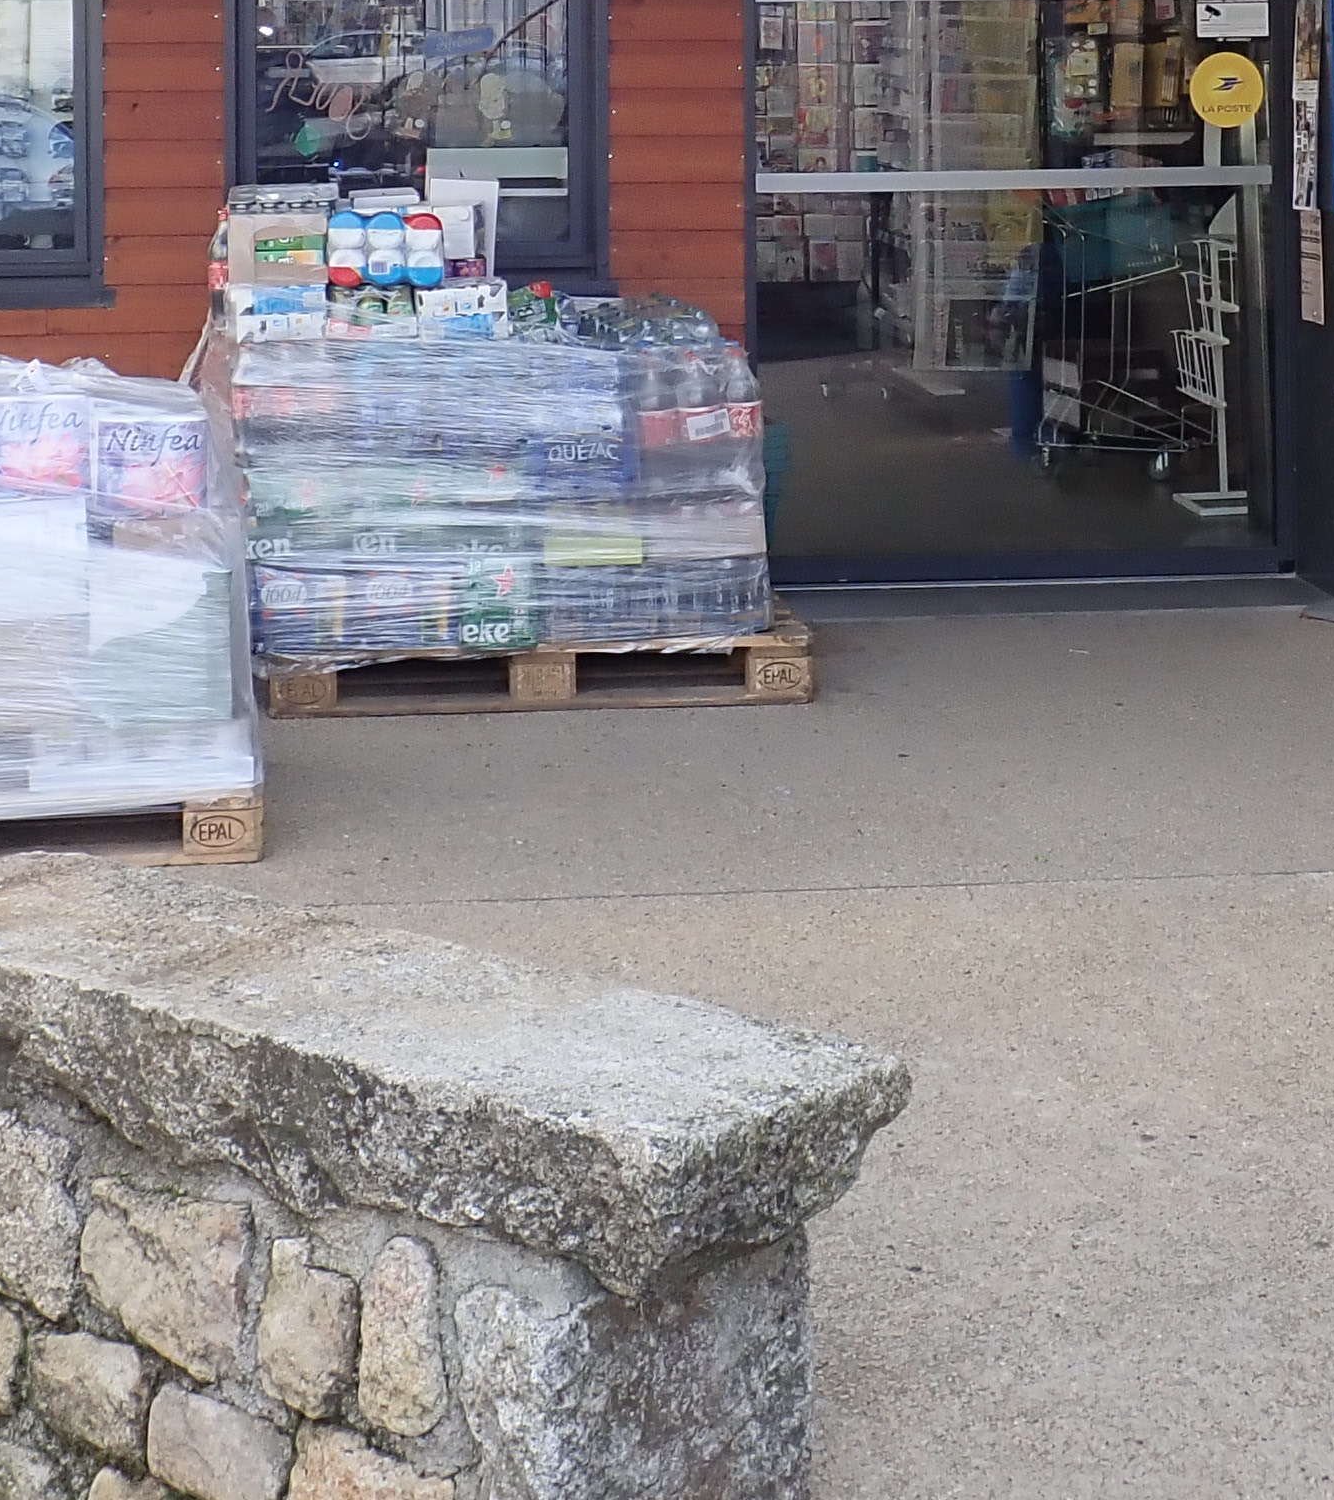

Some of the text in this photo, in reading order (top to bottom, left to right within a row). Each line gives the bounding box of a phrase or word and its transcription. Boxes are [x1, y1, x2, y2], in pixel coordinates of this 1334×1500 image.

[1201, 104, 1252, 113] LA POSTE
[106, 424, 201, 467] Ninfea
[548, 439, 620, 462] QUÉZAC
[763, 668, 796, 684] EPAL
[198, 822, 235, 841] EPAL
